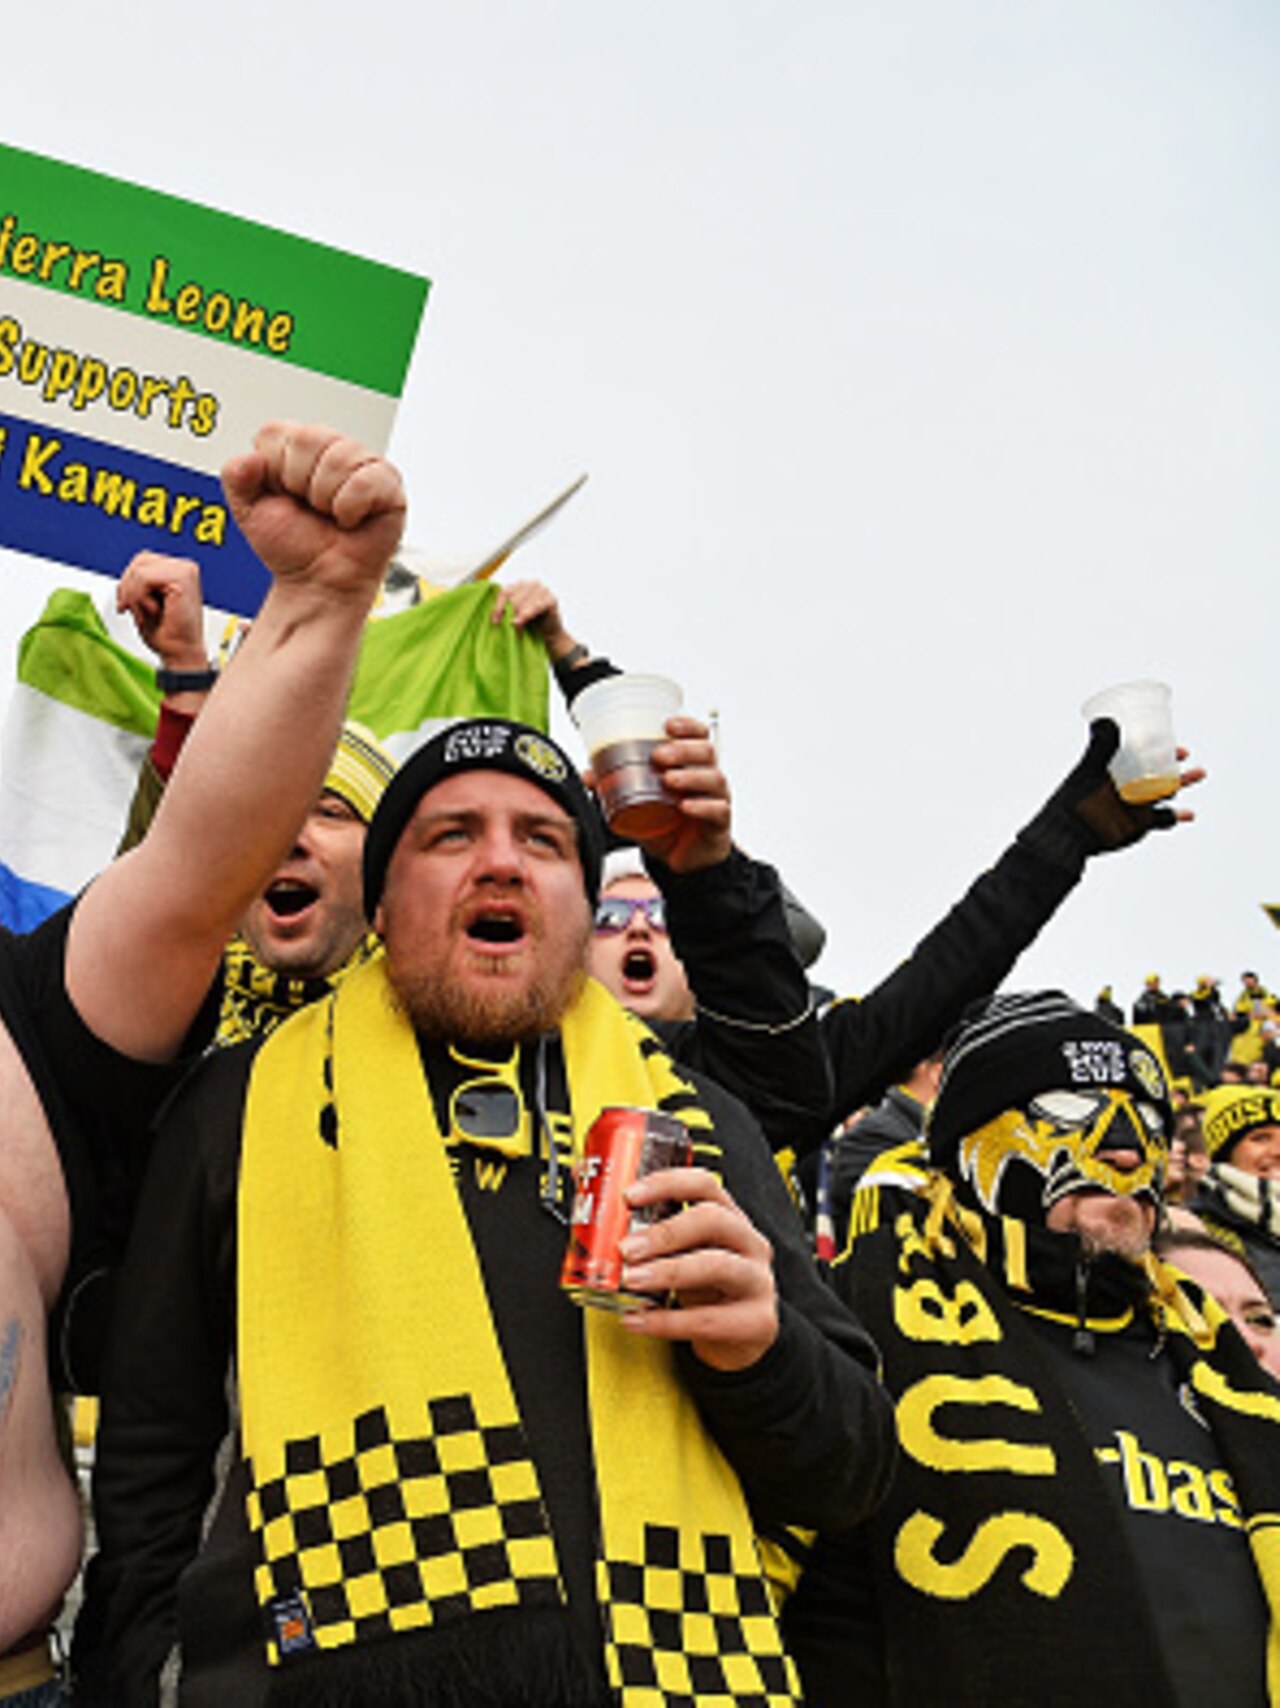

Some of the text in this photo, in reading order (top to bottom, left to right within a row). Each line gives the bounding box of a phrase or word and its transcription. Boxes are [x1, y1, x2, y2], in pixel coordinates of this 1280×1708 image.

[146, 255, 295, 354] Leone
[18, 433, 227, 547] Kamara
[1093, 1429, 1245, 1531] bas
